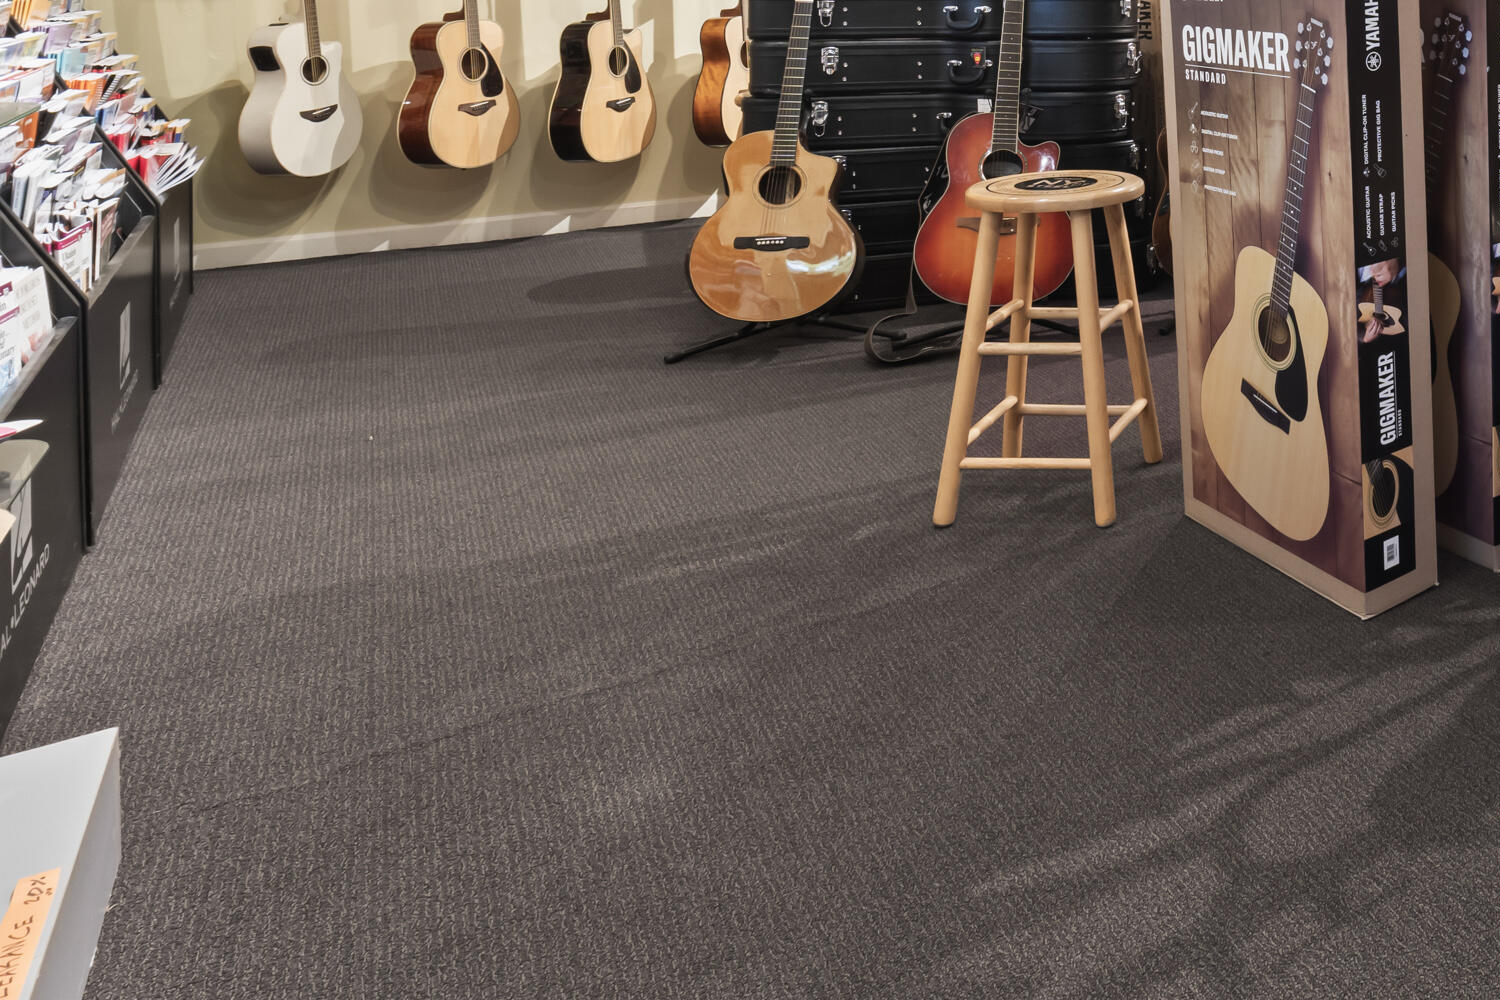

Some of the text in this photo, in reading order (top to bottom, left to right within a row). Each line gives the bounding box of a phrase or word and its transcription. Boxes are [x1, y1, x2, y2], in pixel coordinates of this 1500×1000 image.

[1181, 24, 1291, 73] GIGMAKER
[1185, 68, 1227, 85] STANDARD
[1378, 351, 1396, 446] GIGMAKER
[0, 543, 50, 662] AL LEONARD
[0, 914, 34, 1000] LEARANCE
